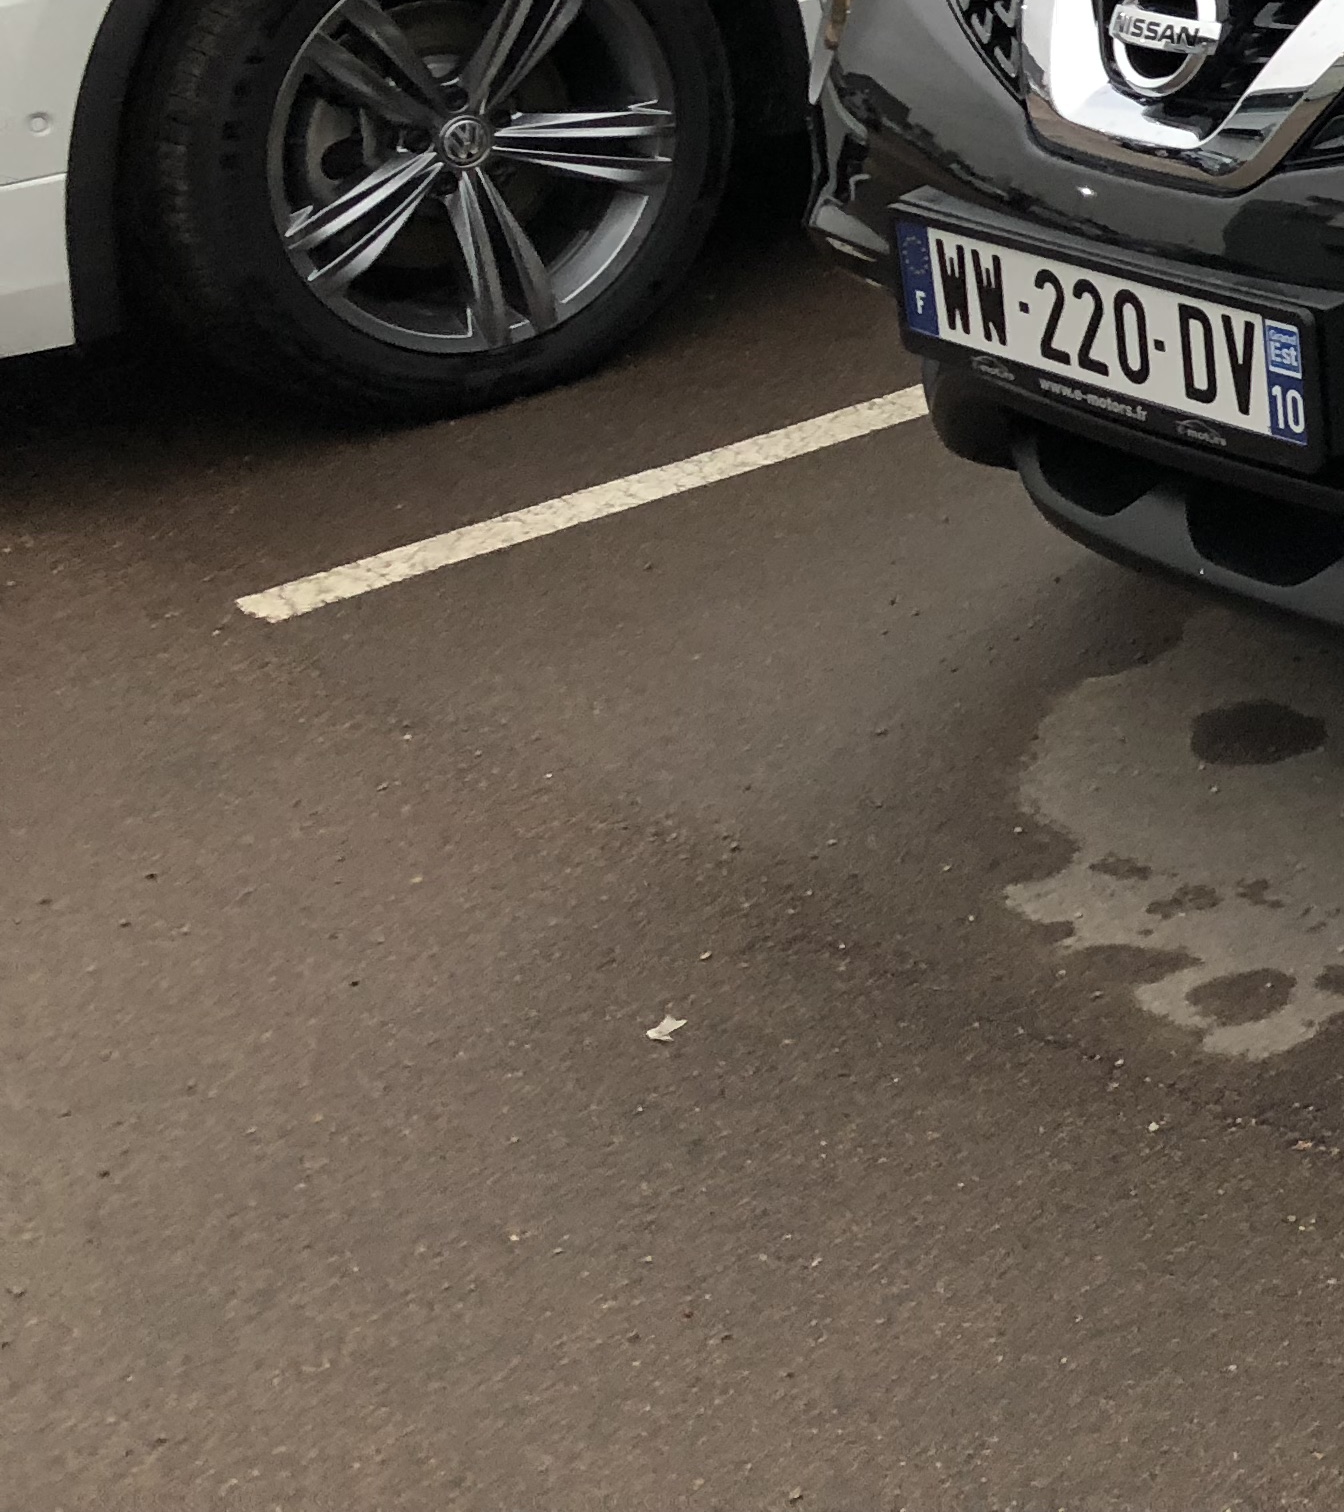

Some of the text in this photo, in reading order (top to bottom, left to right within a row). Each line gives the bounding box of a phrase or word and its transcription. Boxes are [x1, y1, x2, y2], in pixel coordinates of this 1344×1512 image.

[1113, 11, 1200, 47] NISSAN
[915, 289, 926, 316] F
[1270, 340, 1298, 367] Est
[1039, 377, 1148, 423] www.e-motors.fr
[1271, 385, 1306, 434] 10
